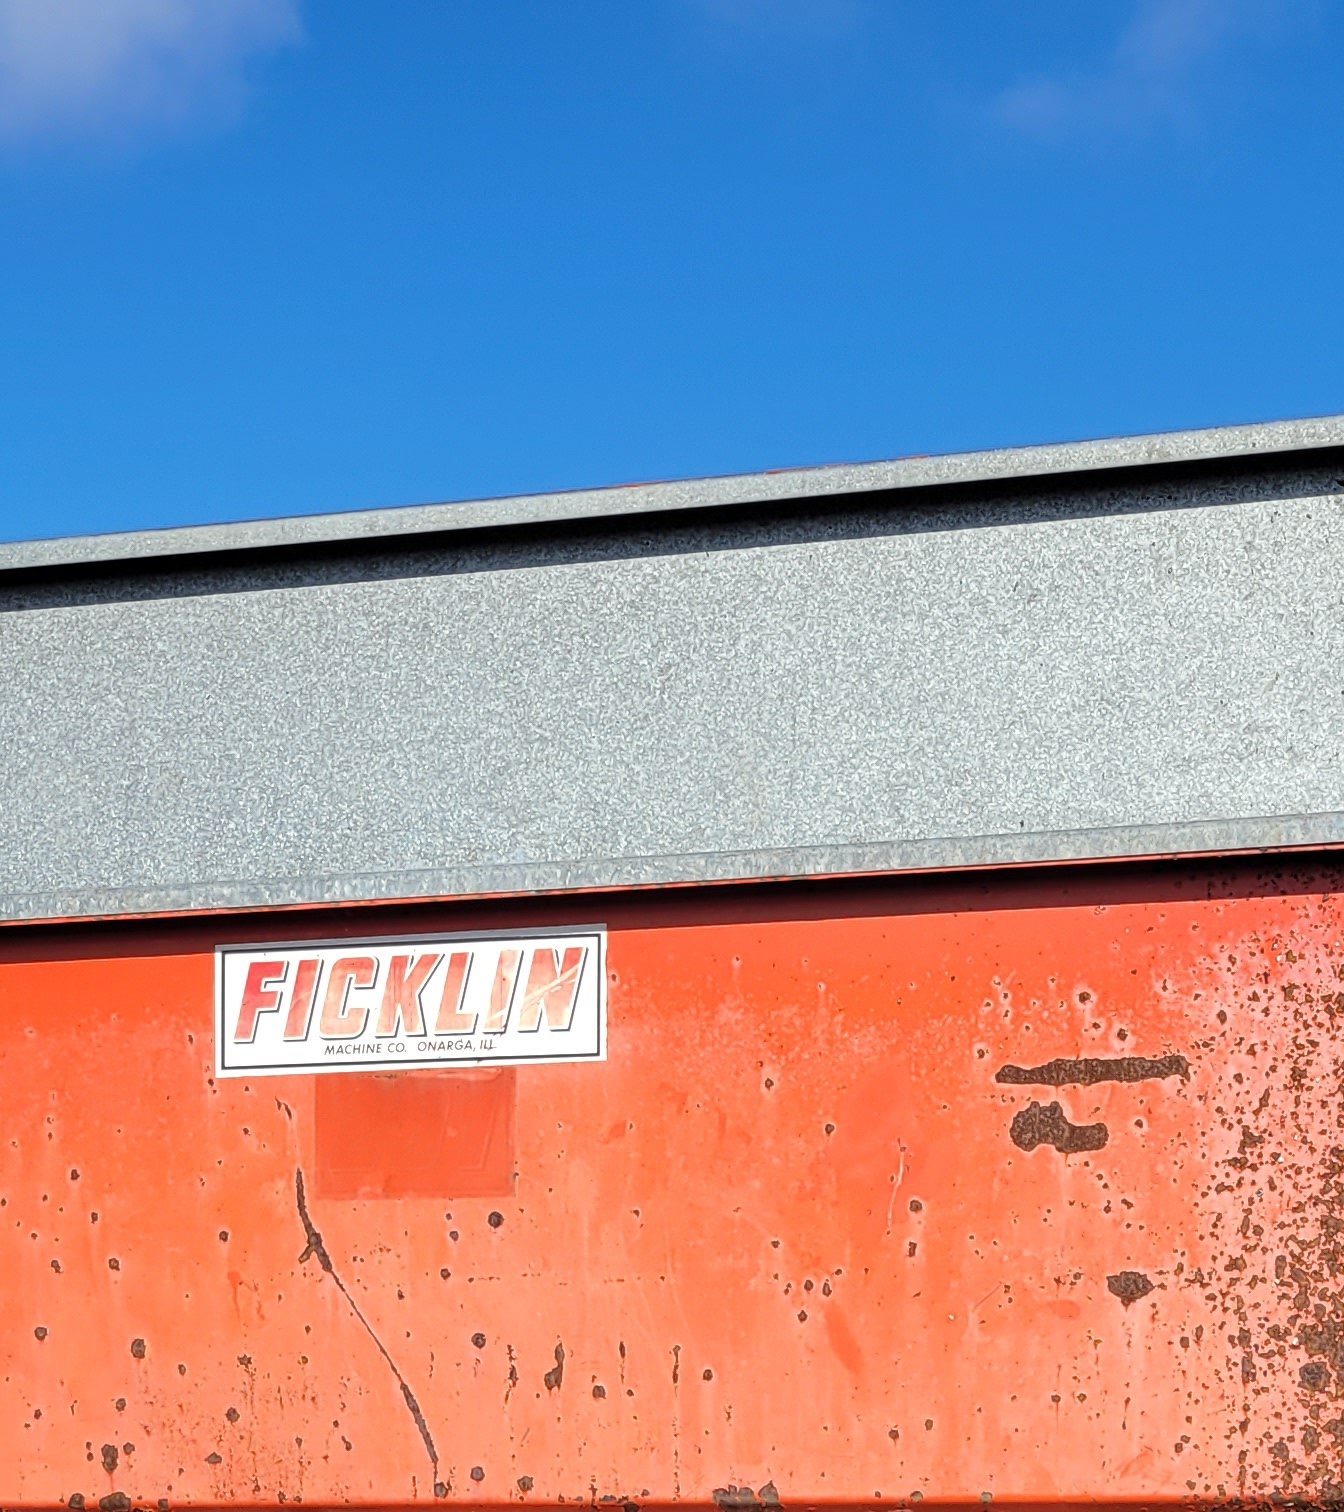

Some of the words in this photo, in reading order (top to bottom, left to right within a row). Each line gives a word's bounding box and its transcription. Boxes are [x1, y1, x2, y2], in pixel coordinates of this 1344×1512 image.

[232, 947, 588, 1044] FICKLIN
[324, 1043, 382, 1055] MACHINE
[387, 1042, 407, 1053] CO.
[417, 1039, 476, 1052] ONARGA,
